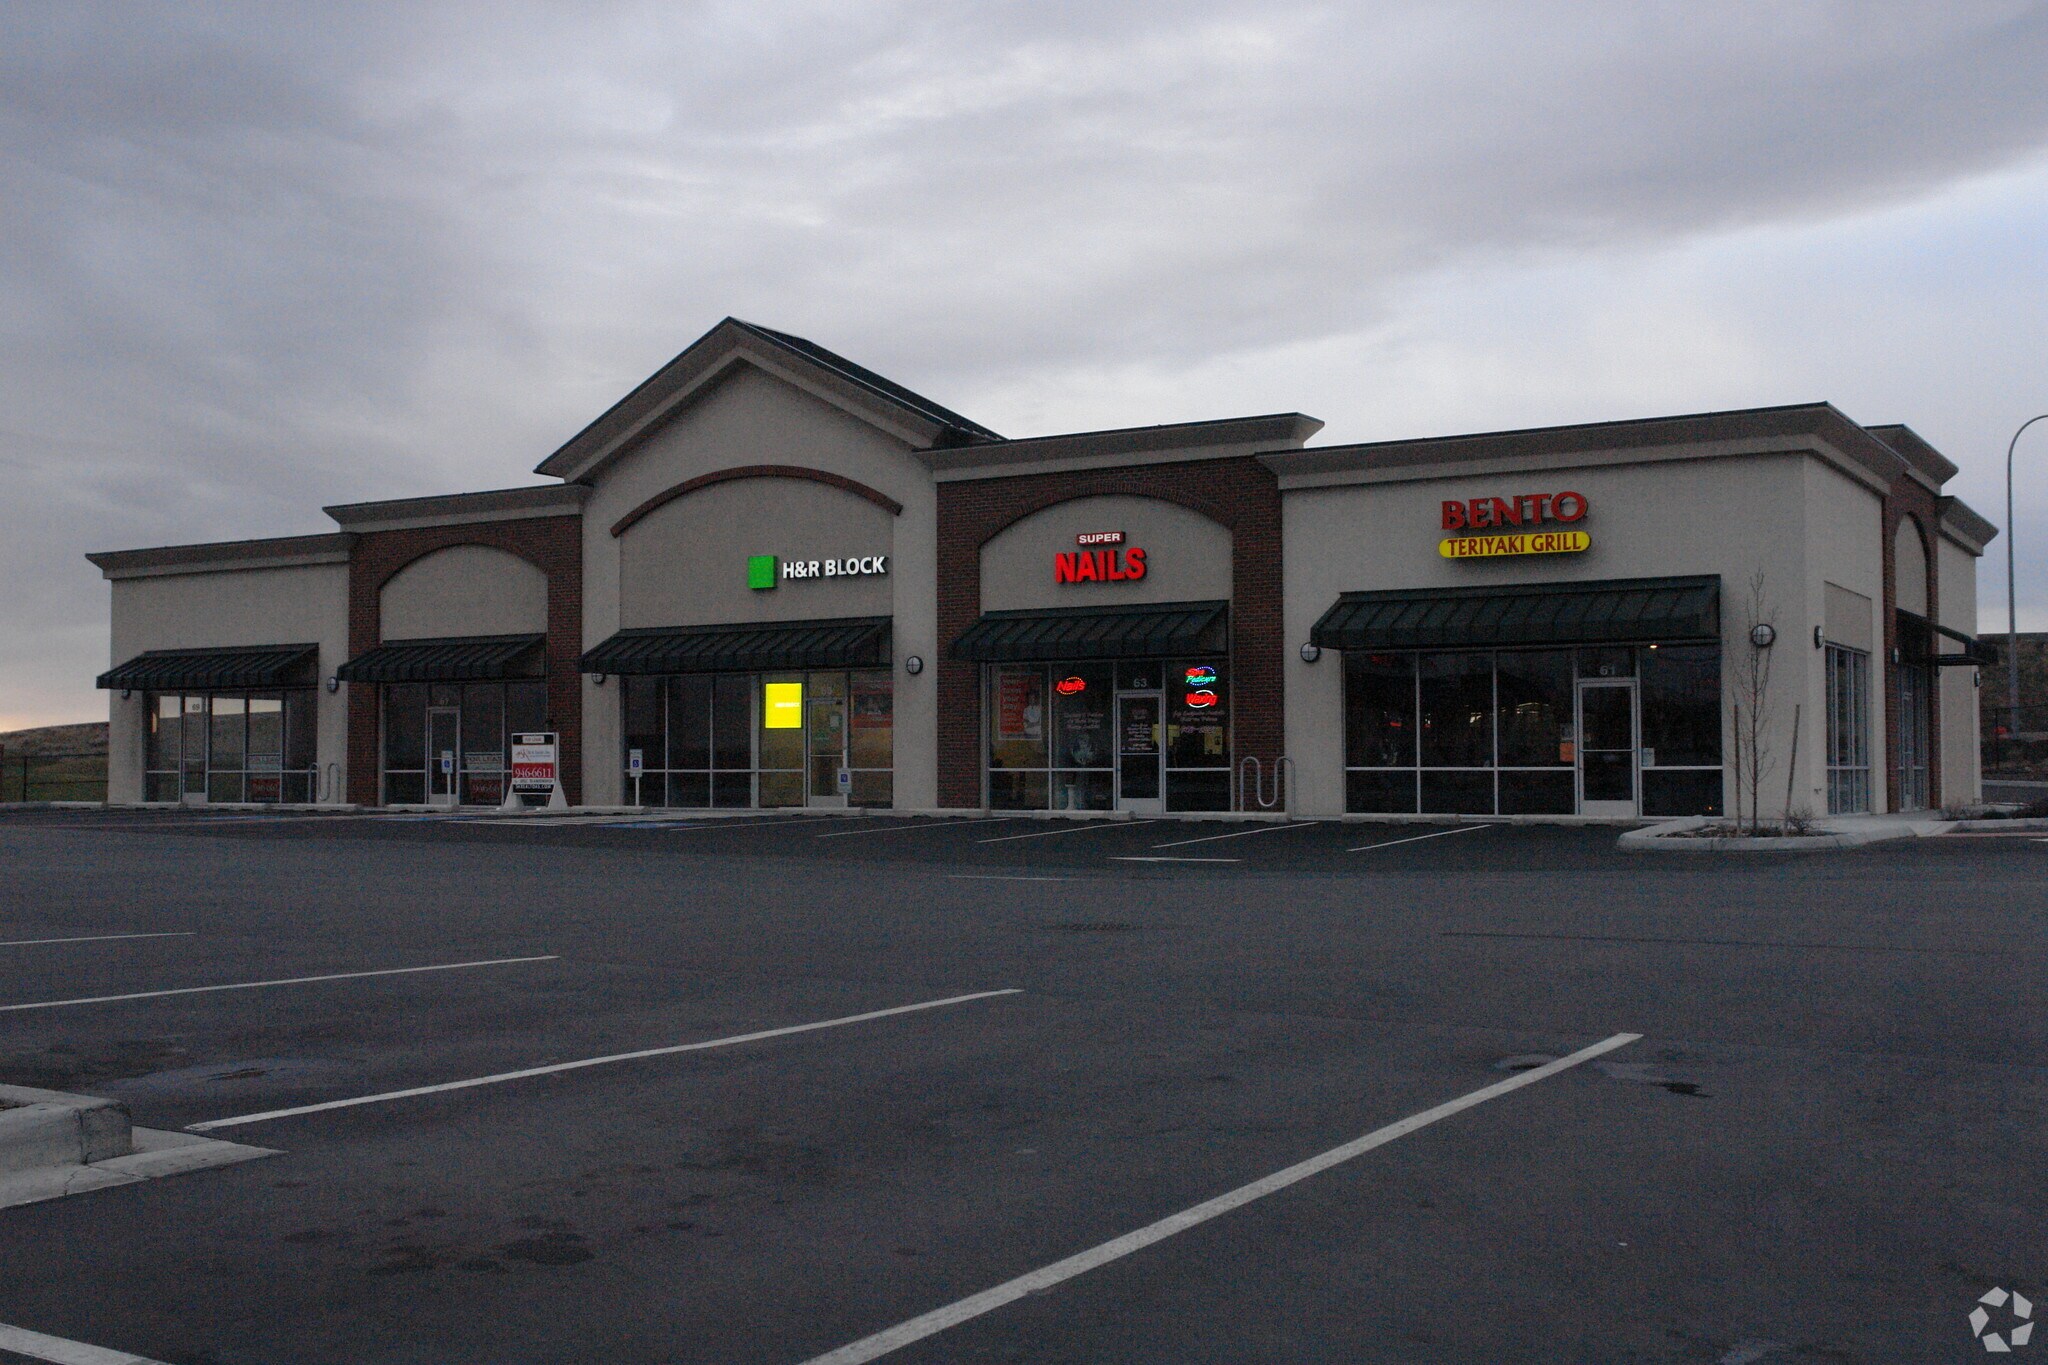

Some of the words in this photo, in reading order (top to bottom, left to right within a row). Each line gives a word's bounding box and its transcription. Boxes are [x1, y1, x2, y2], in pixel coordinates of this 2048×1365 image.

[1441, 491, 1588, 530] BENTO
[1079, 533, 1121, 544] SUPER
[1448, 536, 1525, 556] TERIYAKI
[1531, 533, 1581, 552] GRILL
[783, 560, 820, 579] H&R
[825, 556, 887, 577] BLOCK
[1055, 547, 1147, 583] NAILS
[1599, 665, 1616, 676] 61
[1056, 680, 1087, 692] Nails
[1133, 678, 1147, 688] 63
[1186, 693, 1218, 706] Waxing
[515, 768, 552, 778] 946-6611
